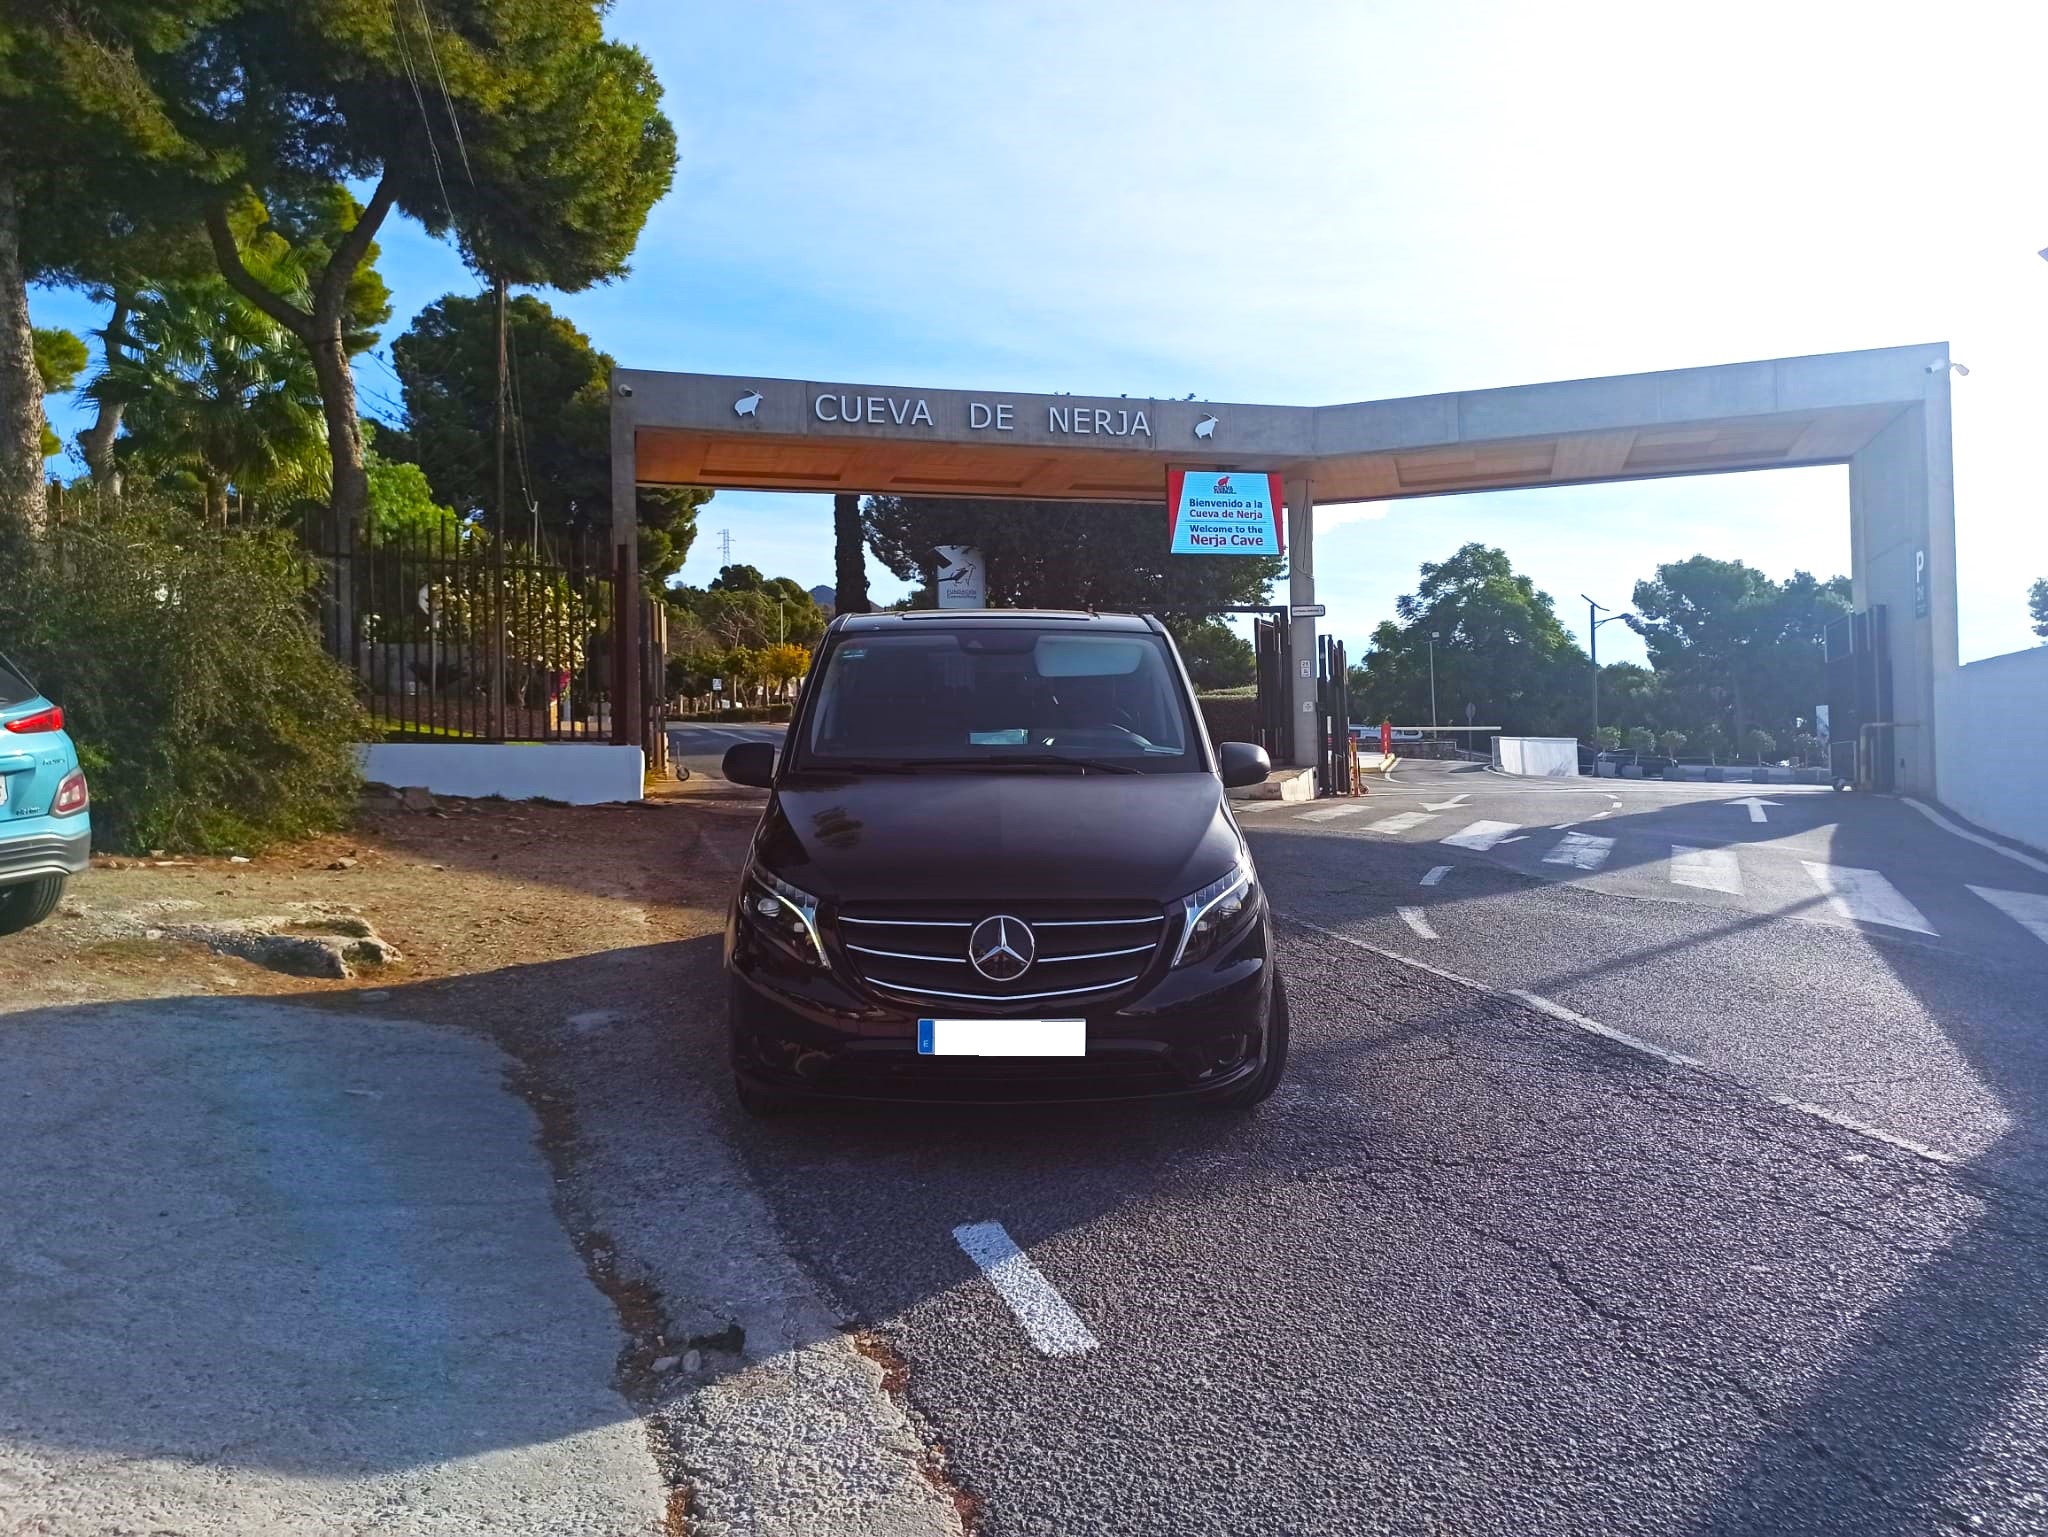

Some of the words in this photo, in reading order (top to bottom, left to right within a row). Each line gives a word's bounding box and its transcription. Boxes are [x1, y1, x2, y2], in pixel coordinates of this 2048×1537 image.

[815, 394, 934, 426] CUEVA
[970, 402, 1014, 430] DE
[1049, 407, 1151, 437] NERJA
[1189, 498, 1243, 508] Bienvenido
[1254, 500, 1263, 509] la
[1189, 509, 1219, 518] Cueva
[1222, 510, 1233, 518] de
[1236, 510, 1263, 521] Nerja
[1189, 525, 1233, 533] Welcome
[1248, 526, 1263, 534] the
[1190, 534, 1227, 547] Nerja
[1231, 535, 1263, 546] Cave
[1916, 550, 1925, 584] P
